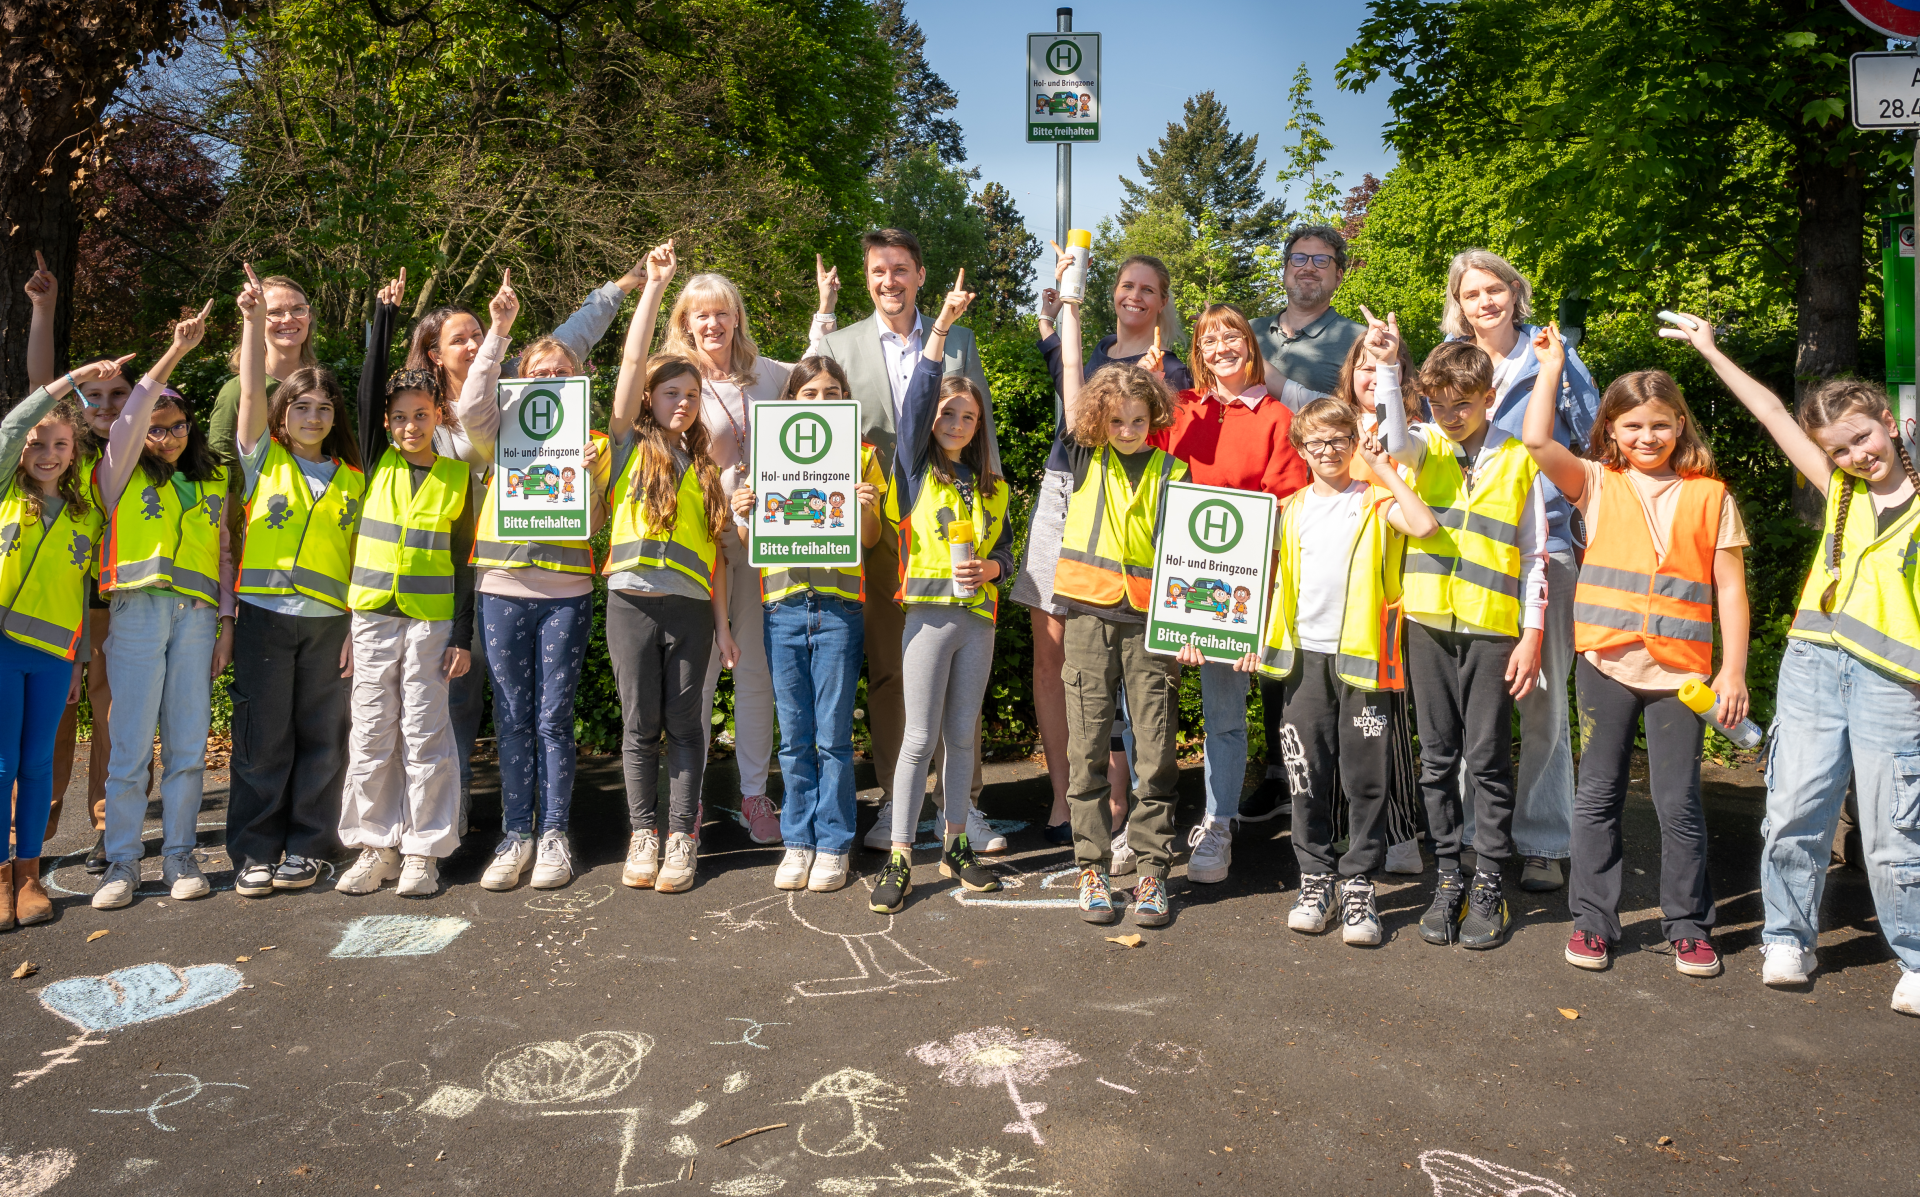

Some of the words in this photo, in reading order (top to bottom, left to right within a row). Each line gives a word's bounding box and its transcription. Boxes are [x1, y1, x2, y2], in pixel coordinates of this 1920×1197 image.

[1057, 47, 1072, 68] H
[1033, 79, 1047, 87] Hol-
[1048, 79, 1060, 87] und
[1061, 79, 1095, 88] Bringzone
[1033, 127, 1053, 136] Bitte
[1054, 127, 1095, 136] freihalten
[532, 400, 550, 430] H
[795, 423, 817, 453] H
[503, 448, 520, 458] Hol-
[521, 447, 537, 457] und
[538, 447, 580, 459] Bringzone
[761, 471, 780, 481] Hol-
[782, 471, 800, 481] und
[803, 471, 850, 483] Bringzone
[503, 516, 529, 529] Bitte
[530, 516, 581, 529] freihalten
[1203, 509, 1229, 543] H
[759, 542, 789, 556] Bitte
[791, 541, 851, 555] freihalten
[1166, 554, 1185, 567] Hol-
[1187, 558, 1207, 571] und
[1208, 559, 1258, 576] Bringzone
[1157, 627, 1188, 645] Bitte
[1190, 632, 1251, 653] freihalten
[1361, 706, 1377, 717] ART
[1363, 726, 1384, 739] EASY
